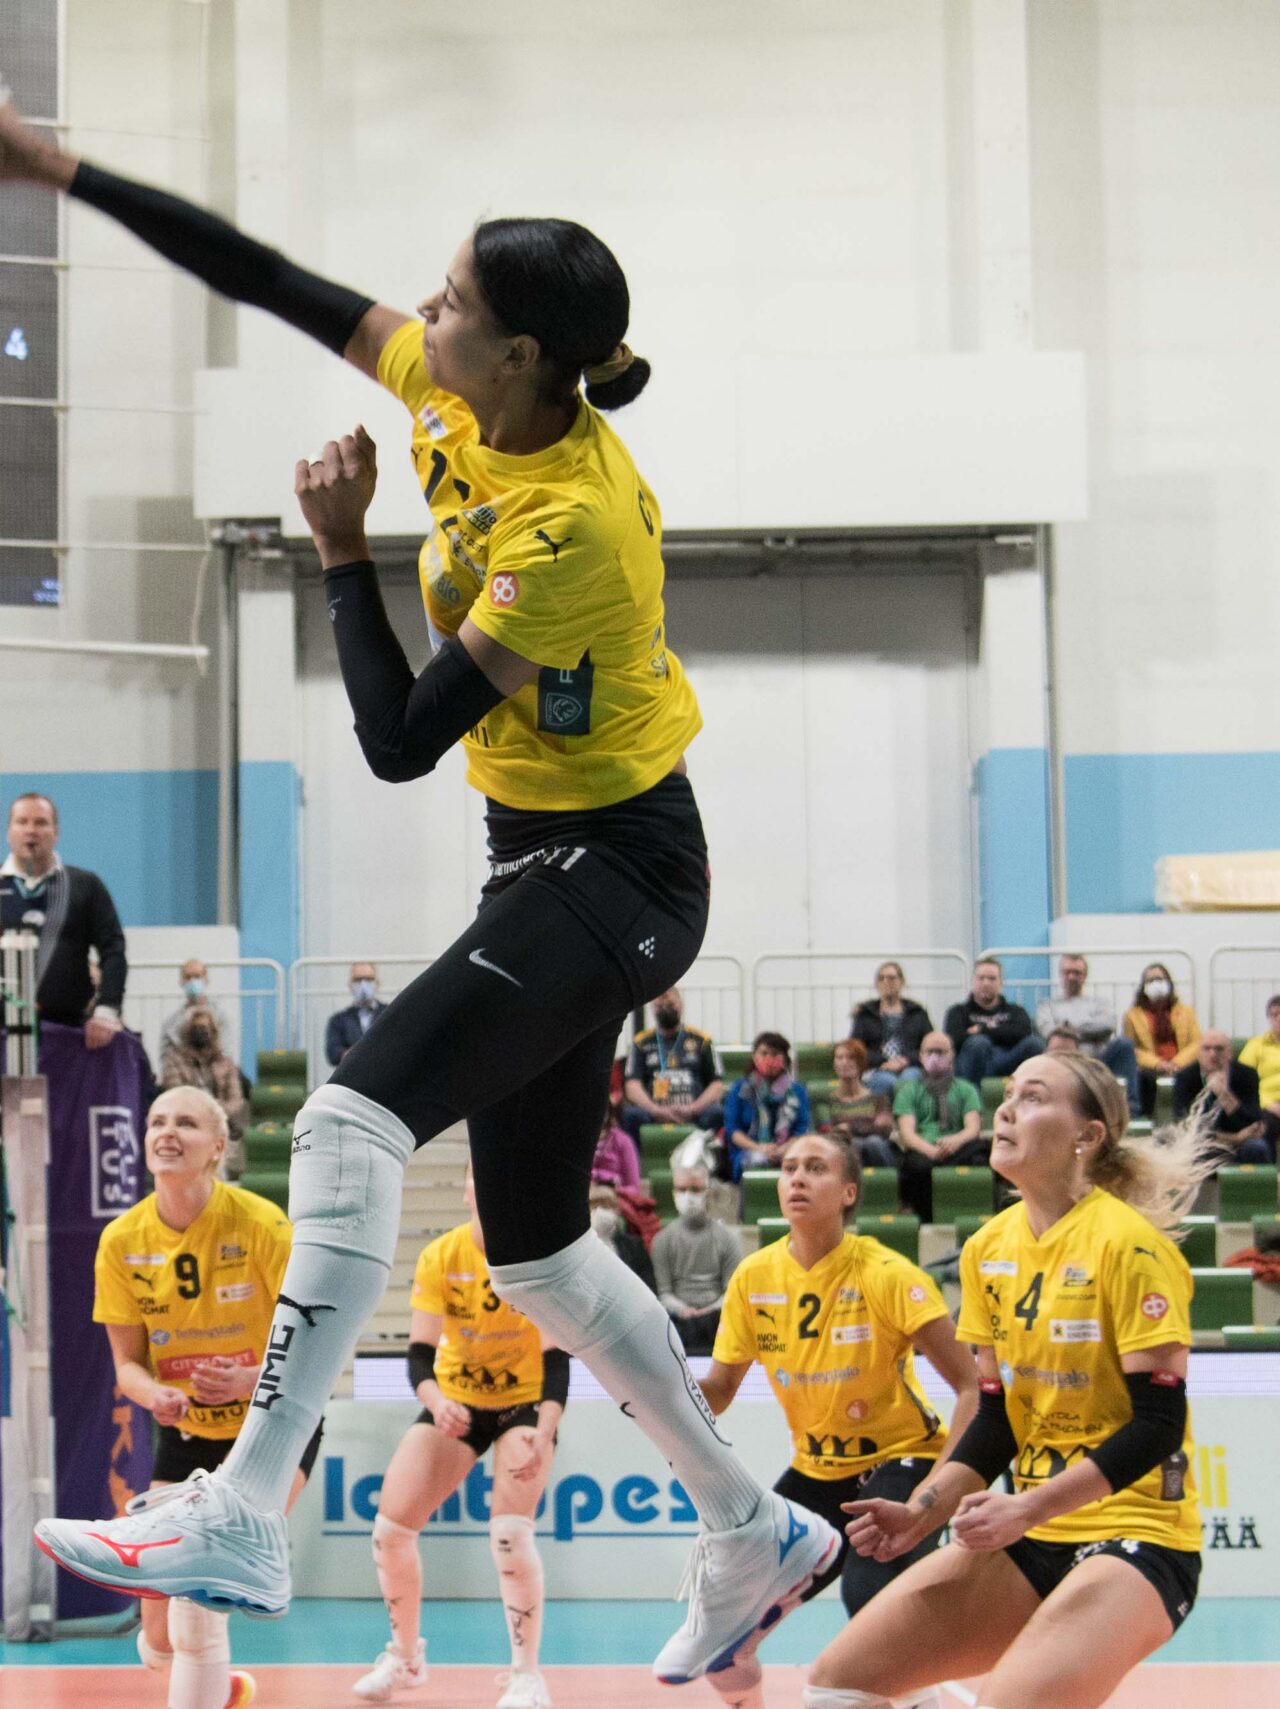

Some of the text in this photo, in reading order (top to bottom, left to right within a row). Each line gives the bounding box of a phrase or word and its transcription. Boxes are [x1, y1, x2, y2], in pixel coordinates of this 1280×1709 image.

[3, 327, 28, 360] 4
[175, 1253, 201, 1300] 9
[798, 1293, 821, 1339] 2
[1014, 1272, 1044, 1331] 4
